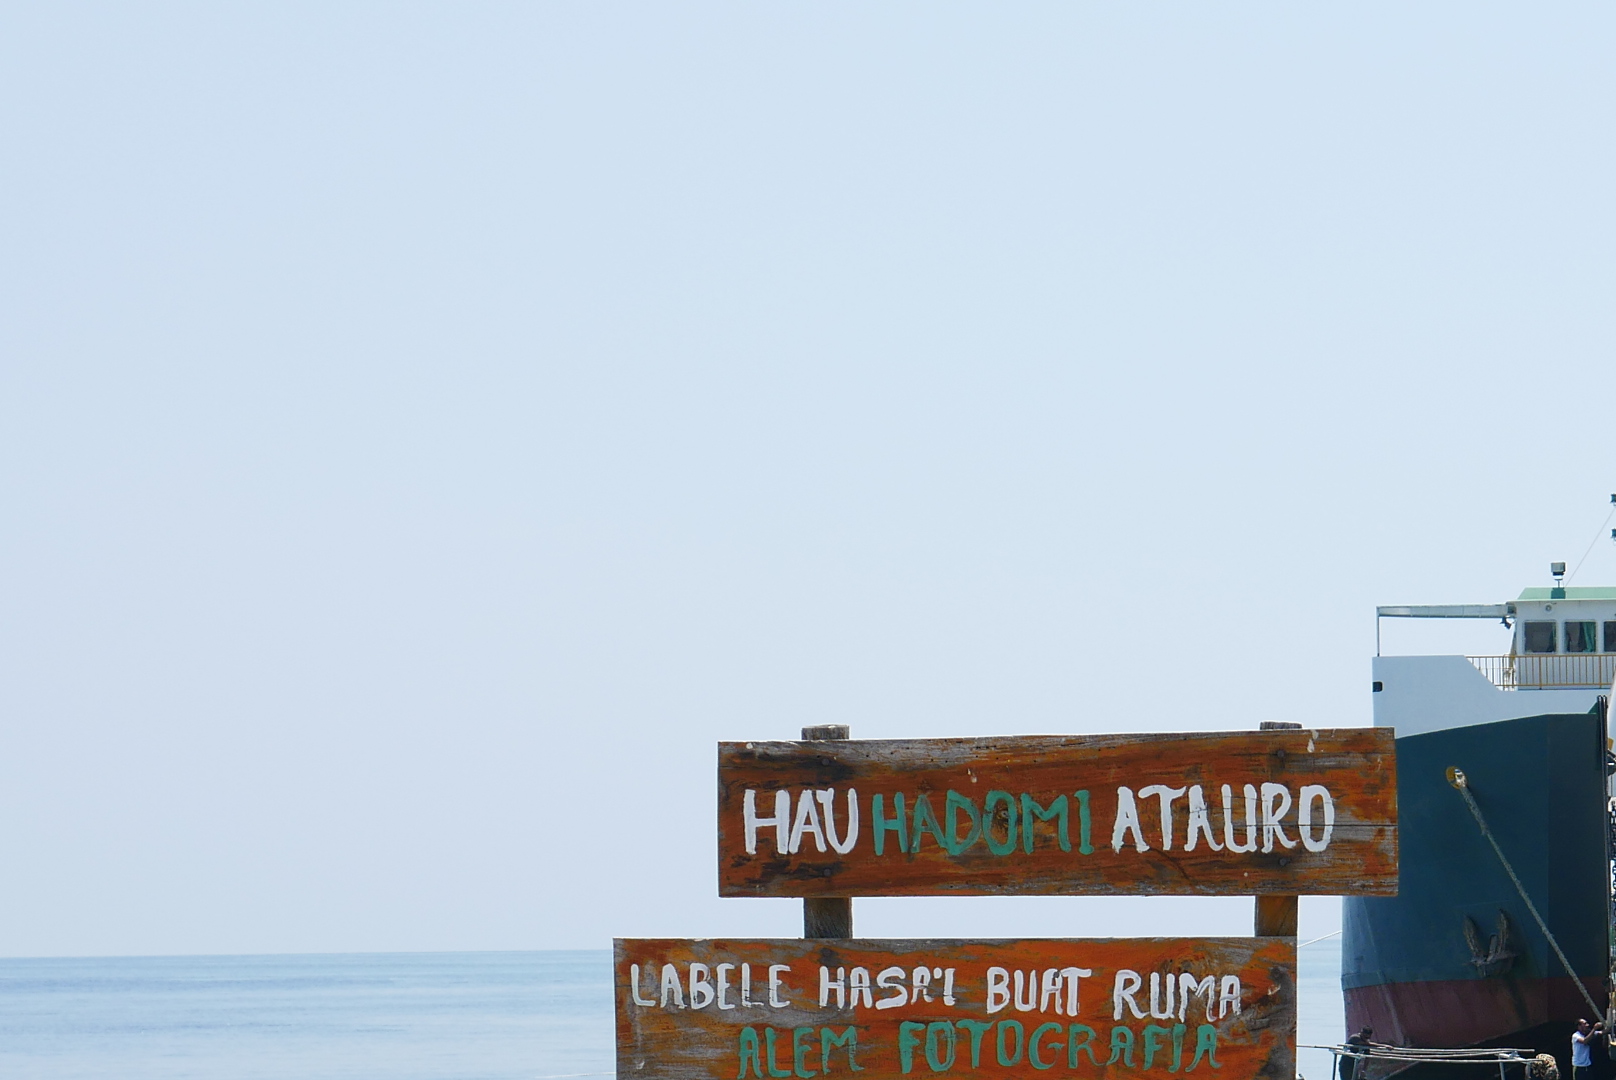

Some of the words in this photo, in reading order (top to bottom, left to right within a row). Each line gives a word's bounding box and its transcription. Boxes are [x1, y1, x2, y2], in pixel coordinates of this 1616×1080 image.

[872, 789, 1094, 856] HADOMI
[1112, 782, 1335, 853] ATAURO
[631, 962, 792, 1010] LABELE
[986, 966, 1092, 1017] BUAT
[1113, 969, 1241, 1023] RUMA
[737, 1025, 865, 1080] ALEM
[899, 1019, 1223, 1074] FOTOGRAFIA
